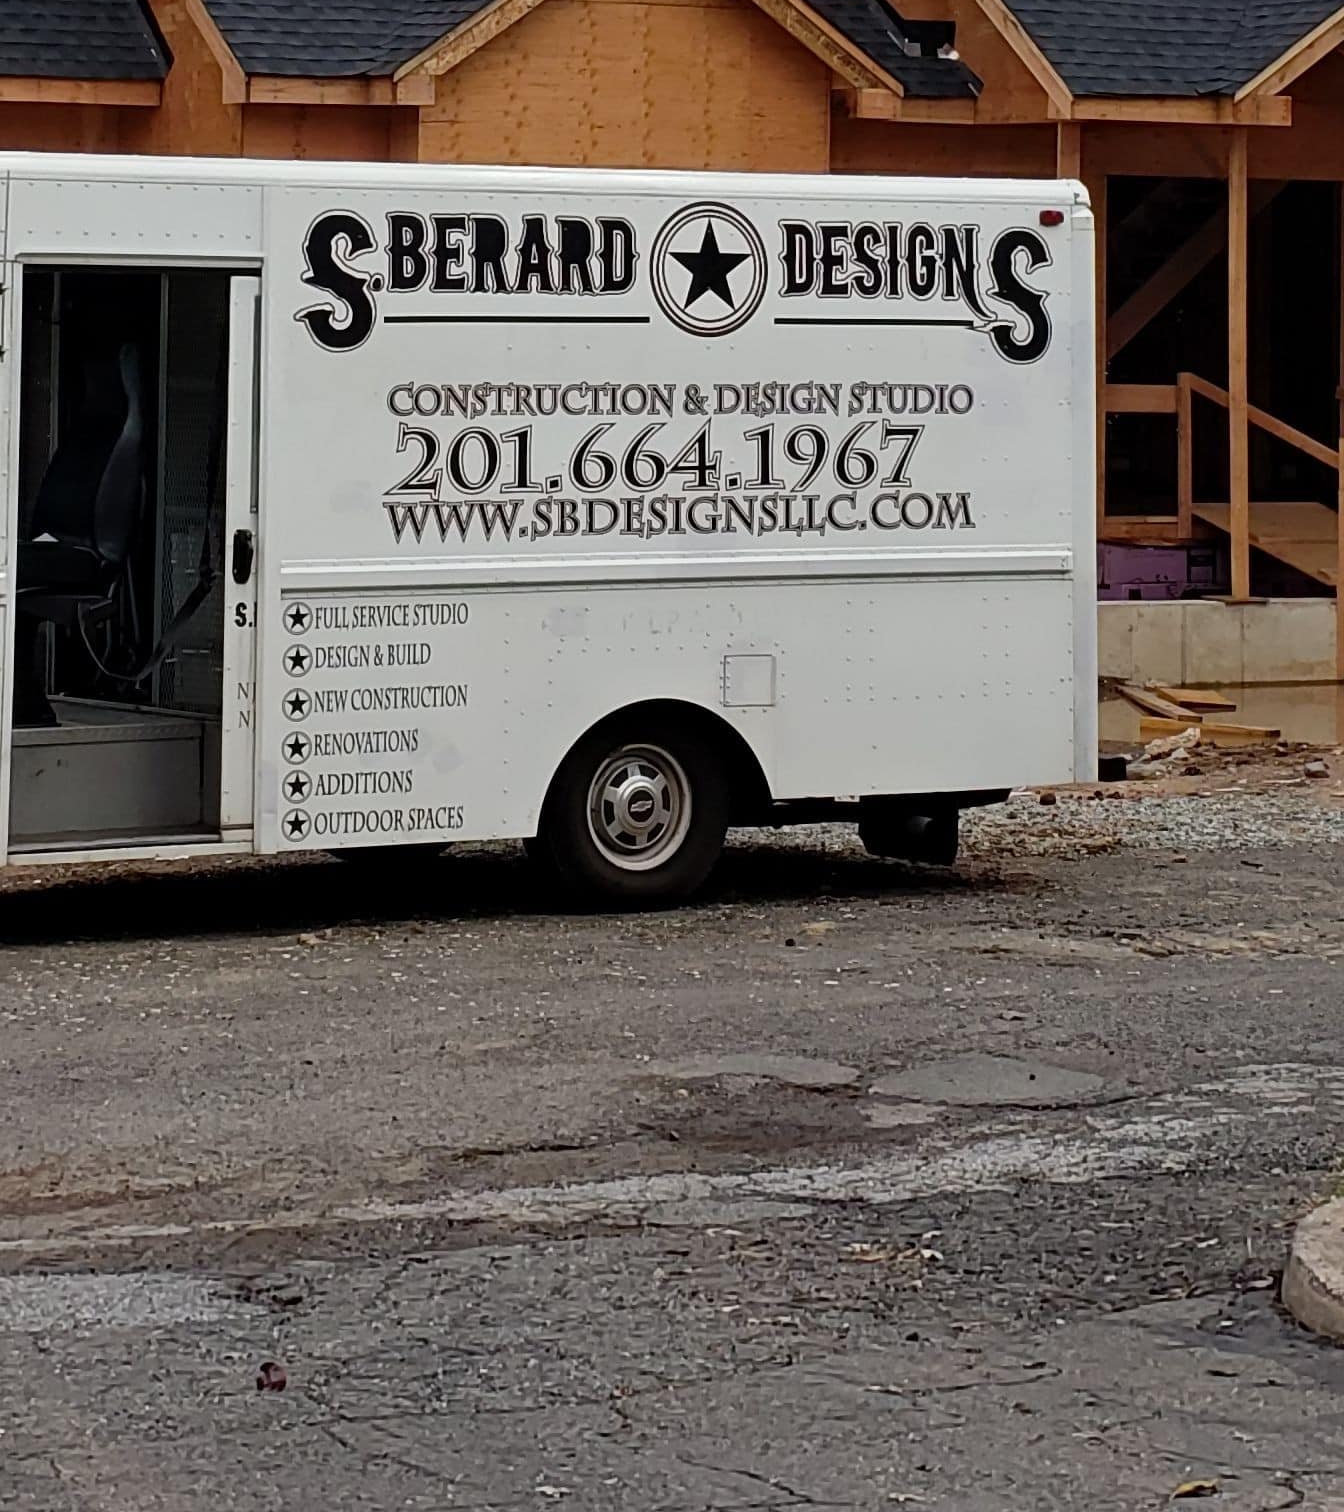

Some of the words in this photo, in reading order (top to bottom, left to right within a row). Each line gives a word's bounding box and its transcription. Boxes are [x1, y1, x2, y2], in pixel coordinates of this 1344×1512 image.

[777, 221, 1054, 365] DESIGNS
[387, 381, 678, 416] CONSTRUCTION
[682, 384, 712, 413] &
[714, 382, 842, 417] DESIGN
[846, 382, 975, 415] STUDIO
[384, 418, 926, 500] 201.664.1967
[383, 493, 976, 541] WWW.SBDESIGNSLLC.COM
[314, 606, 350, 630] FULL
[352, 604, 410, 628] SERVICE
[413, 603, 469, 625] STUDIO
[314, 645, 371, 668] DESIGN
[374, 646, 384, 666] &
[387, 643, 432, 666] BUILD
[314, 689, 348, 712] NEW
[351, 685, 468, 710] CONSTRUCTION
[314, 729, 419, 756] RENOVATIONS
[314, 770, 413, 796] ADDITIONS
[314, 809, 404, 834] OUTDOOR
[408, 806, 464, 831] SPACES
